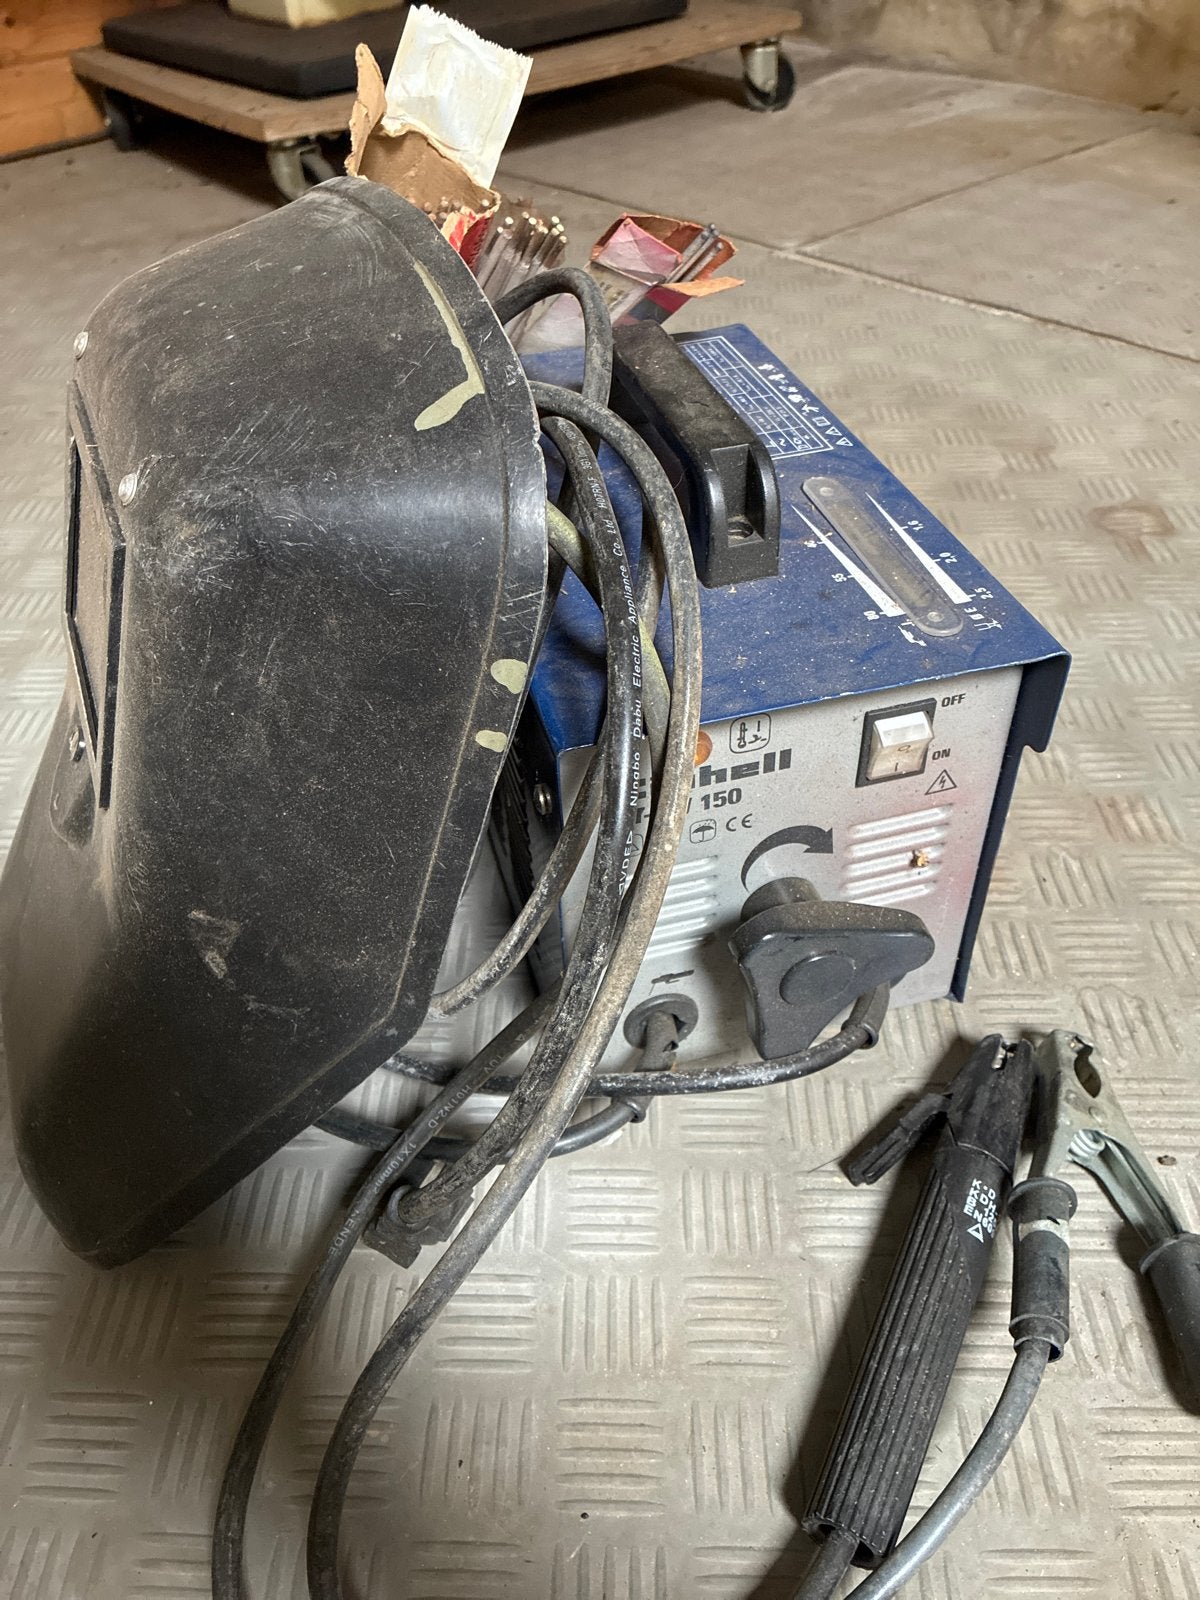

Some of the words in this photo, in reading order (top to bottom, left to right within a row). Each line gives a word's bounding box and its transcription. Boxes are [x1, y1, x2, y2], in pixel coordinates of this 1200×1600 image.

[602, 519, 617, 534] Ltd
[907, 520, 924, 531] 1,6
[939, 552, 958, 564] 2,0
[620, 565, 638, 625] Appliance
[974, 587, 994, 600] 2,5
[631, 635, 641, 687] Electric
[941, 693, 966, 707] OFF
[632, 699, 642, 739] Dabu
[932, 748, 951, 760] ON
[630, 752, 641, 806] Ningbo
[700, 787, 742, 811] 150
[725, 813, 753, 832] CE
[428, 1084, 472, 1129] H01N2-D
